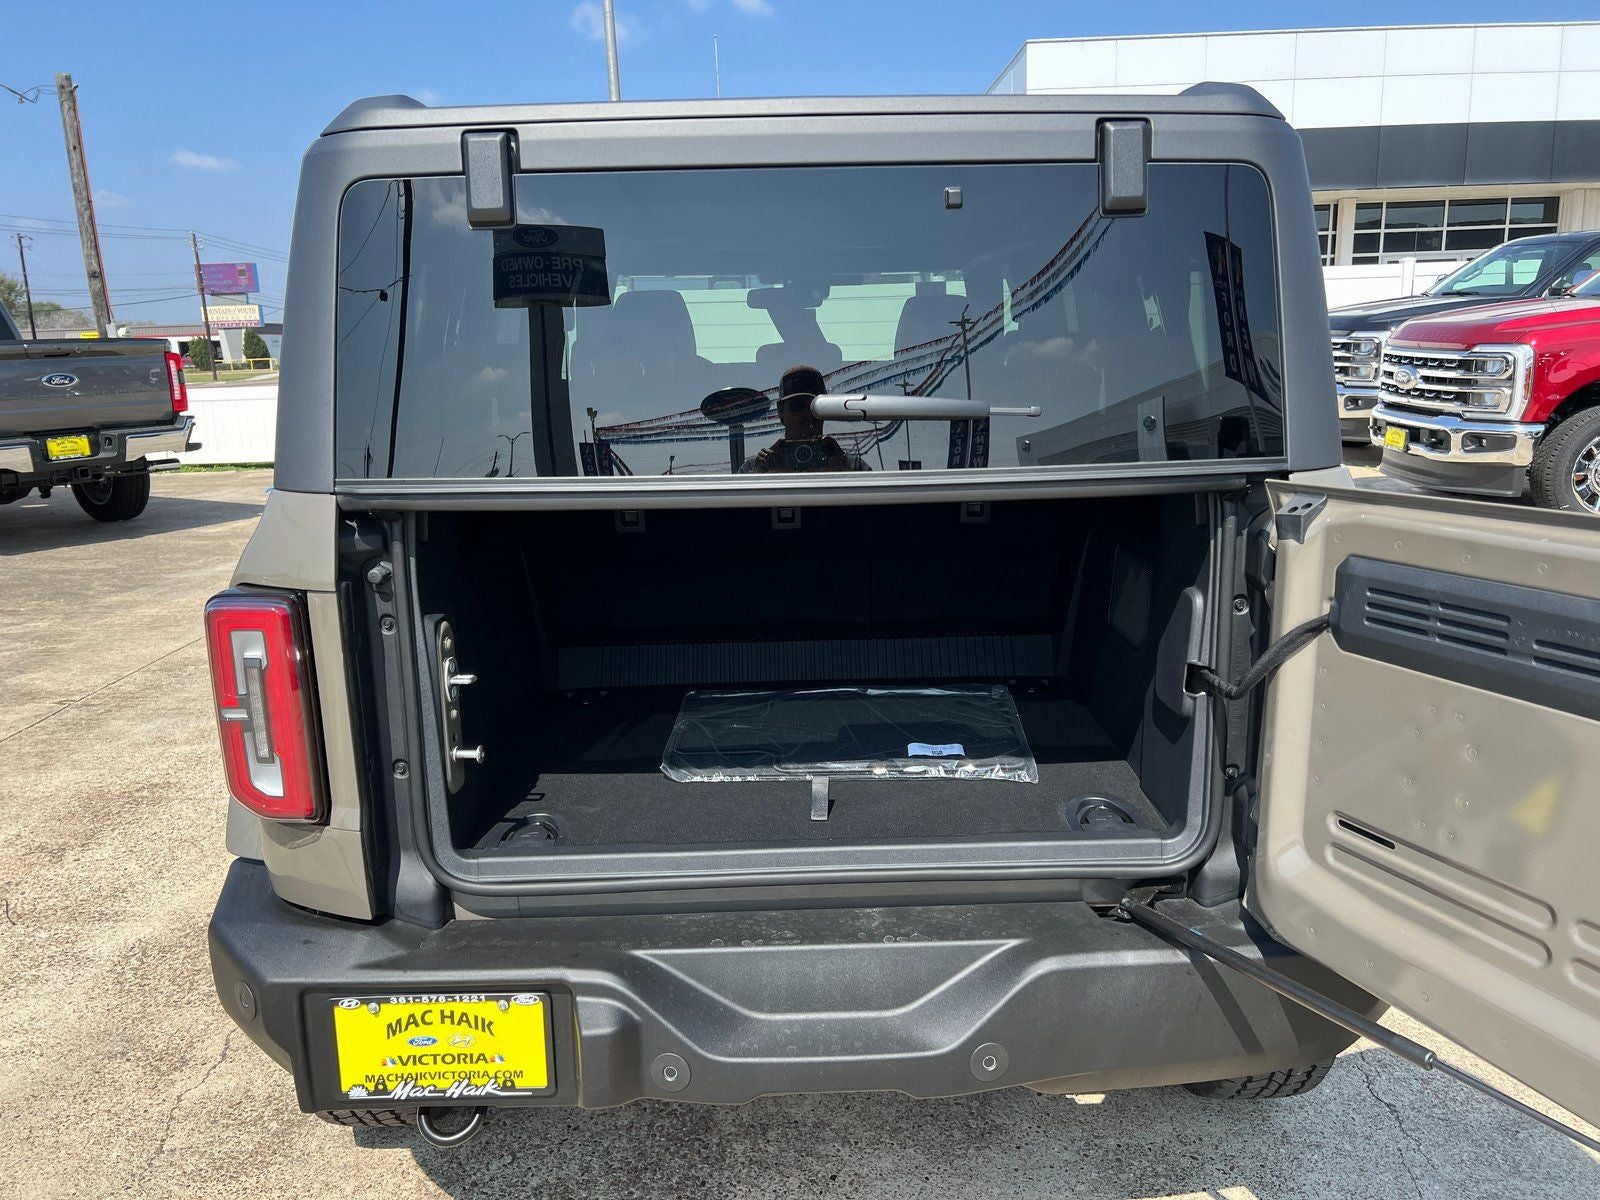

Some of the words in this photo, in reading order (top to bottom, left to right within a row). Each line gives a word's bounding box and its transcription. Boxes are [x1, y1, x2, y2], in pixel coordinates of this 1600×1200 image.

[51, 376, 70, 385] Ford
[390, 995, 486, 1004] 361-576-1221
[386, 1009, 433, 1040] MAC
[440, 1009, 495, 1037] HAIK
[412, 1036, 434, 1046] Ford
[396, 1053, 490, 1067] VICTORIA
[389, 1079, 435, 1100] Mac
[445, 1077, 502, 1099] Haik
